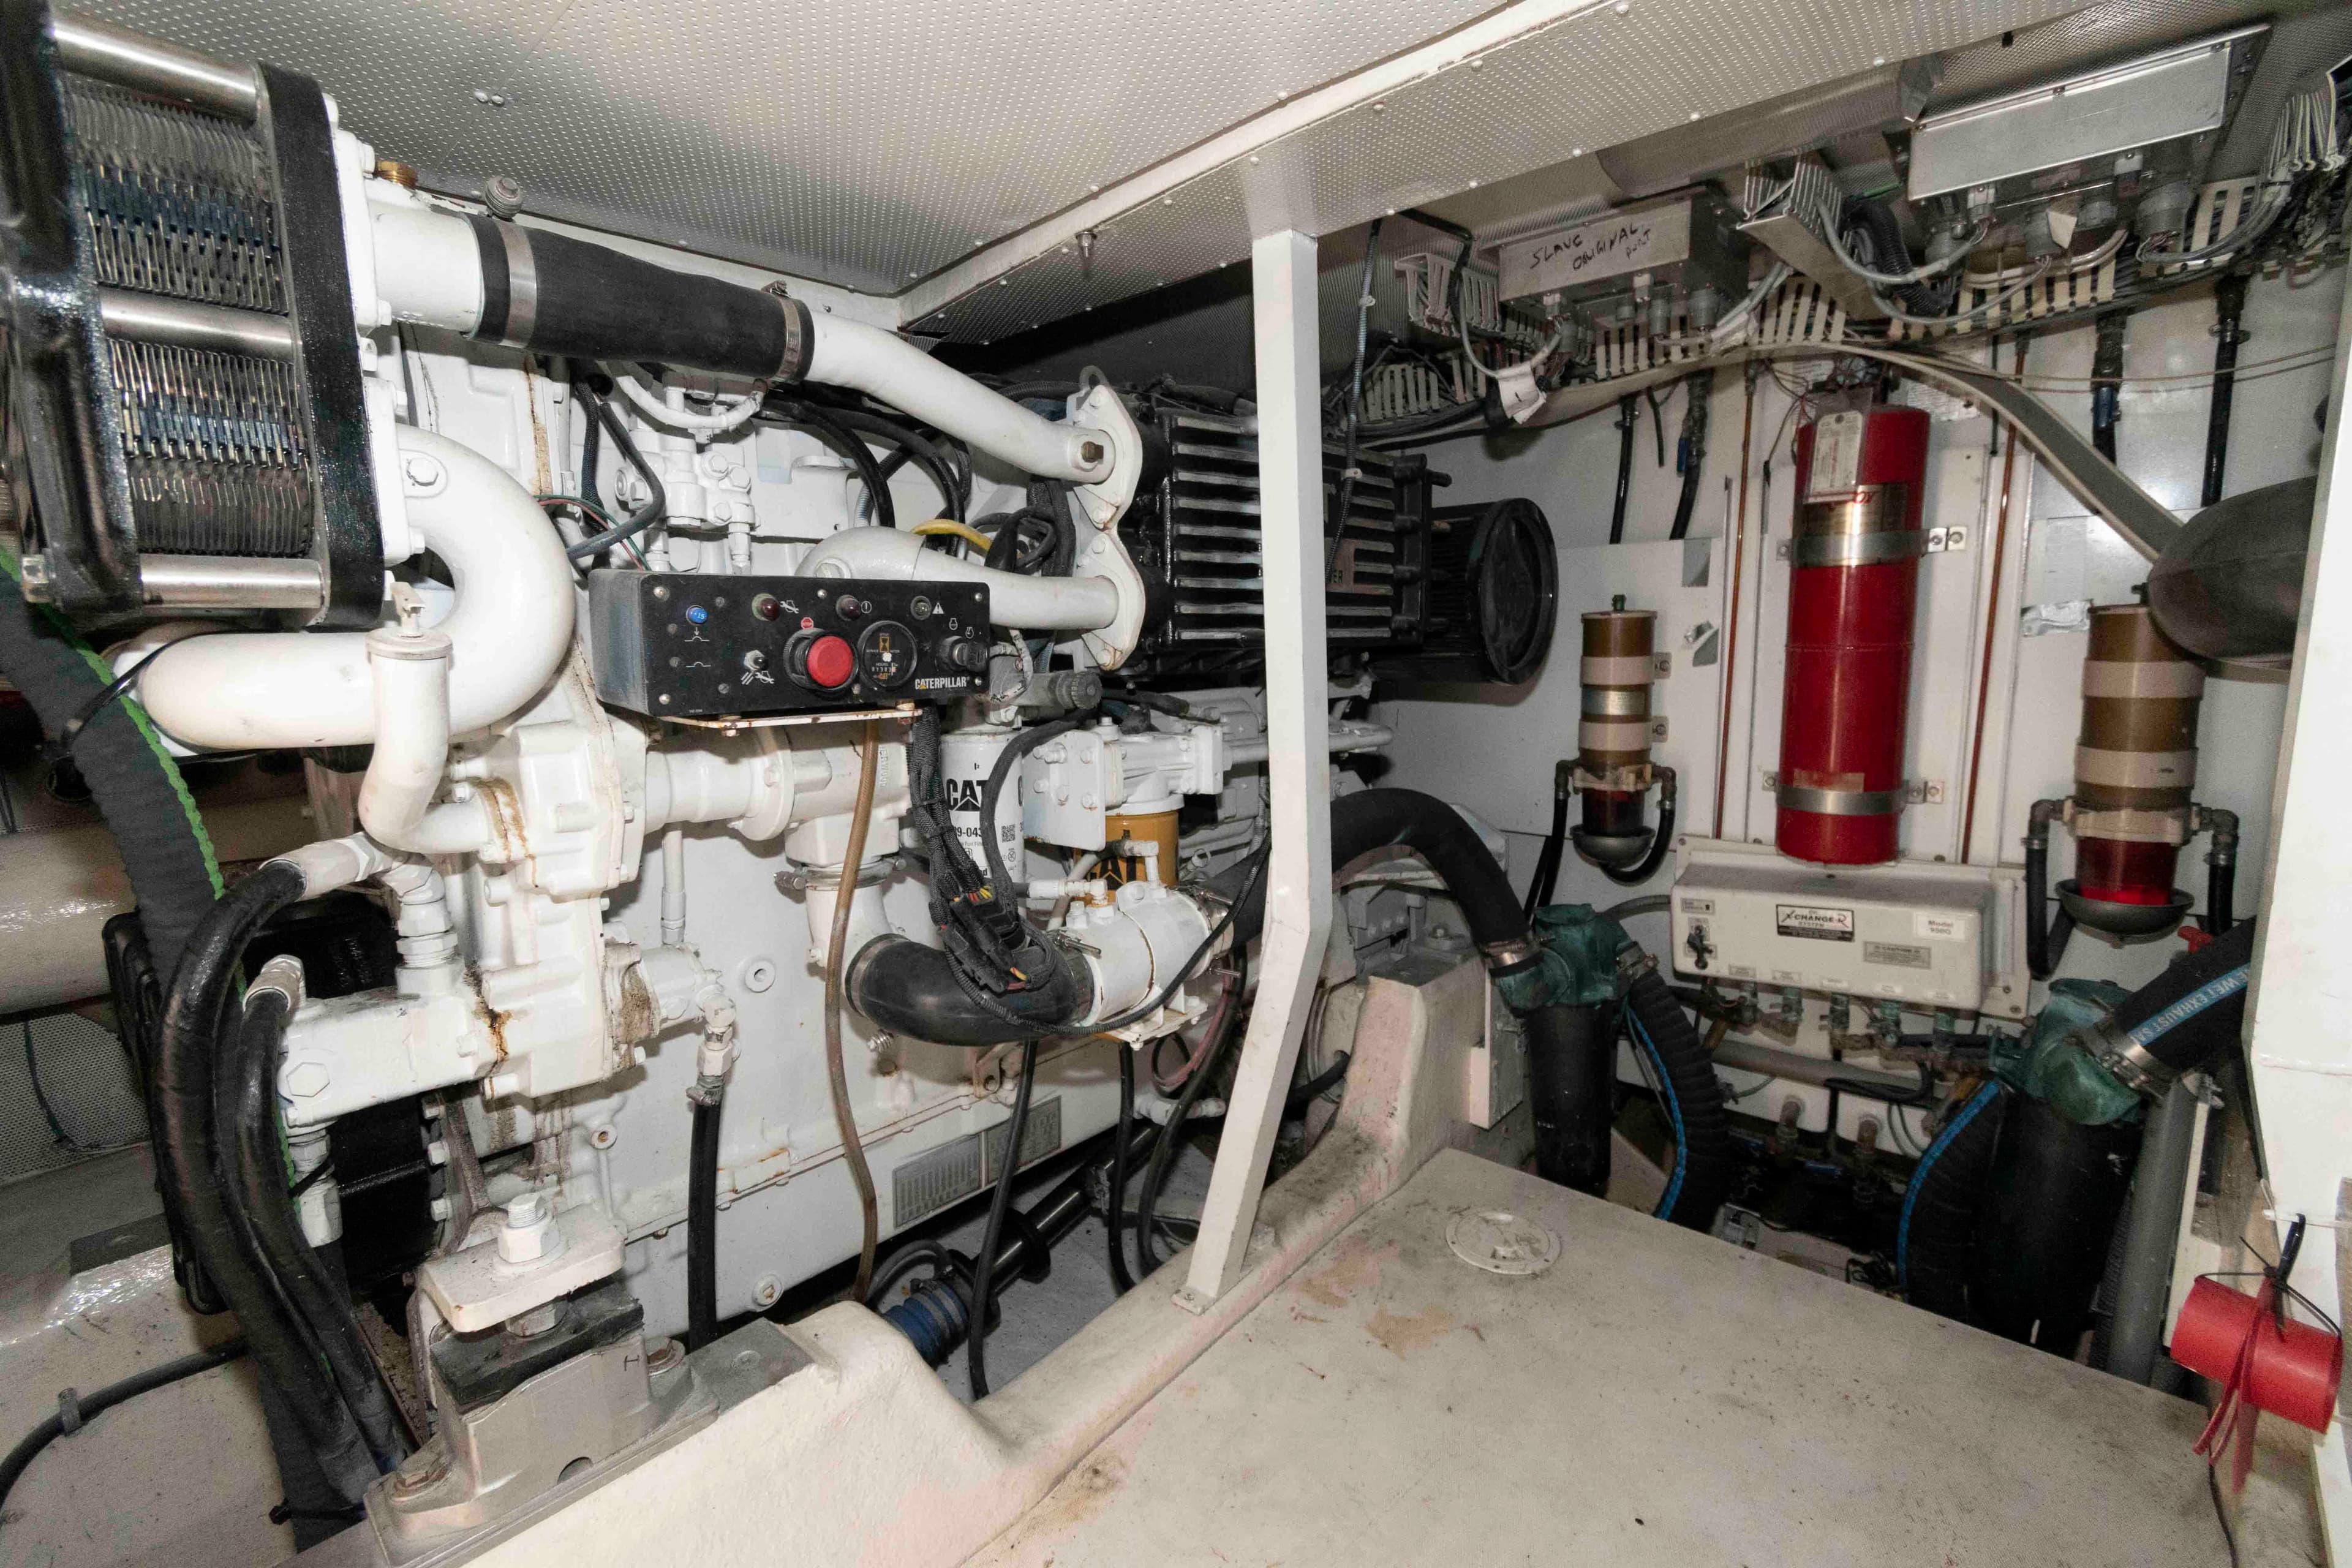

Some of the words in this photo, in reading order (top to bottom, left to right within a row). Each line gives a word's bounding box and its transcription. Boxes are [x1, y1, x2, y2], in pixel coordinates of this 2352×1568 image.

[1572, 222, 1638, 271] ORIGINAL
[914, 676, 967, 690] CATERPILLAR
[2210, 975, 2240, 997] WET
[2155, 993, 2208, 1033] EXHAUST
